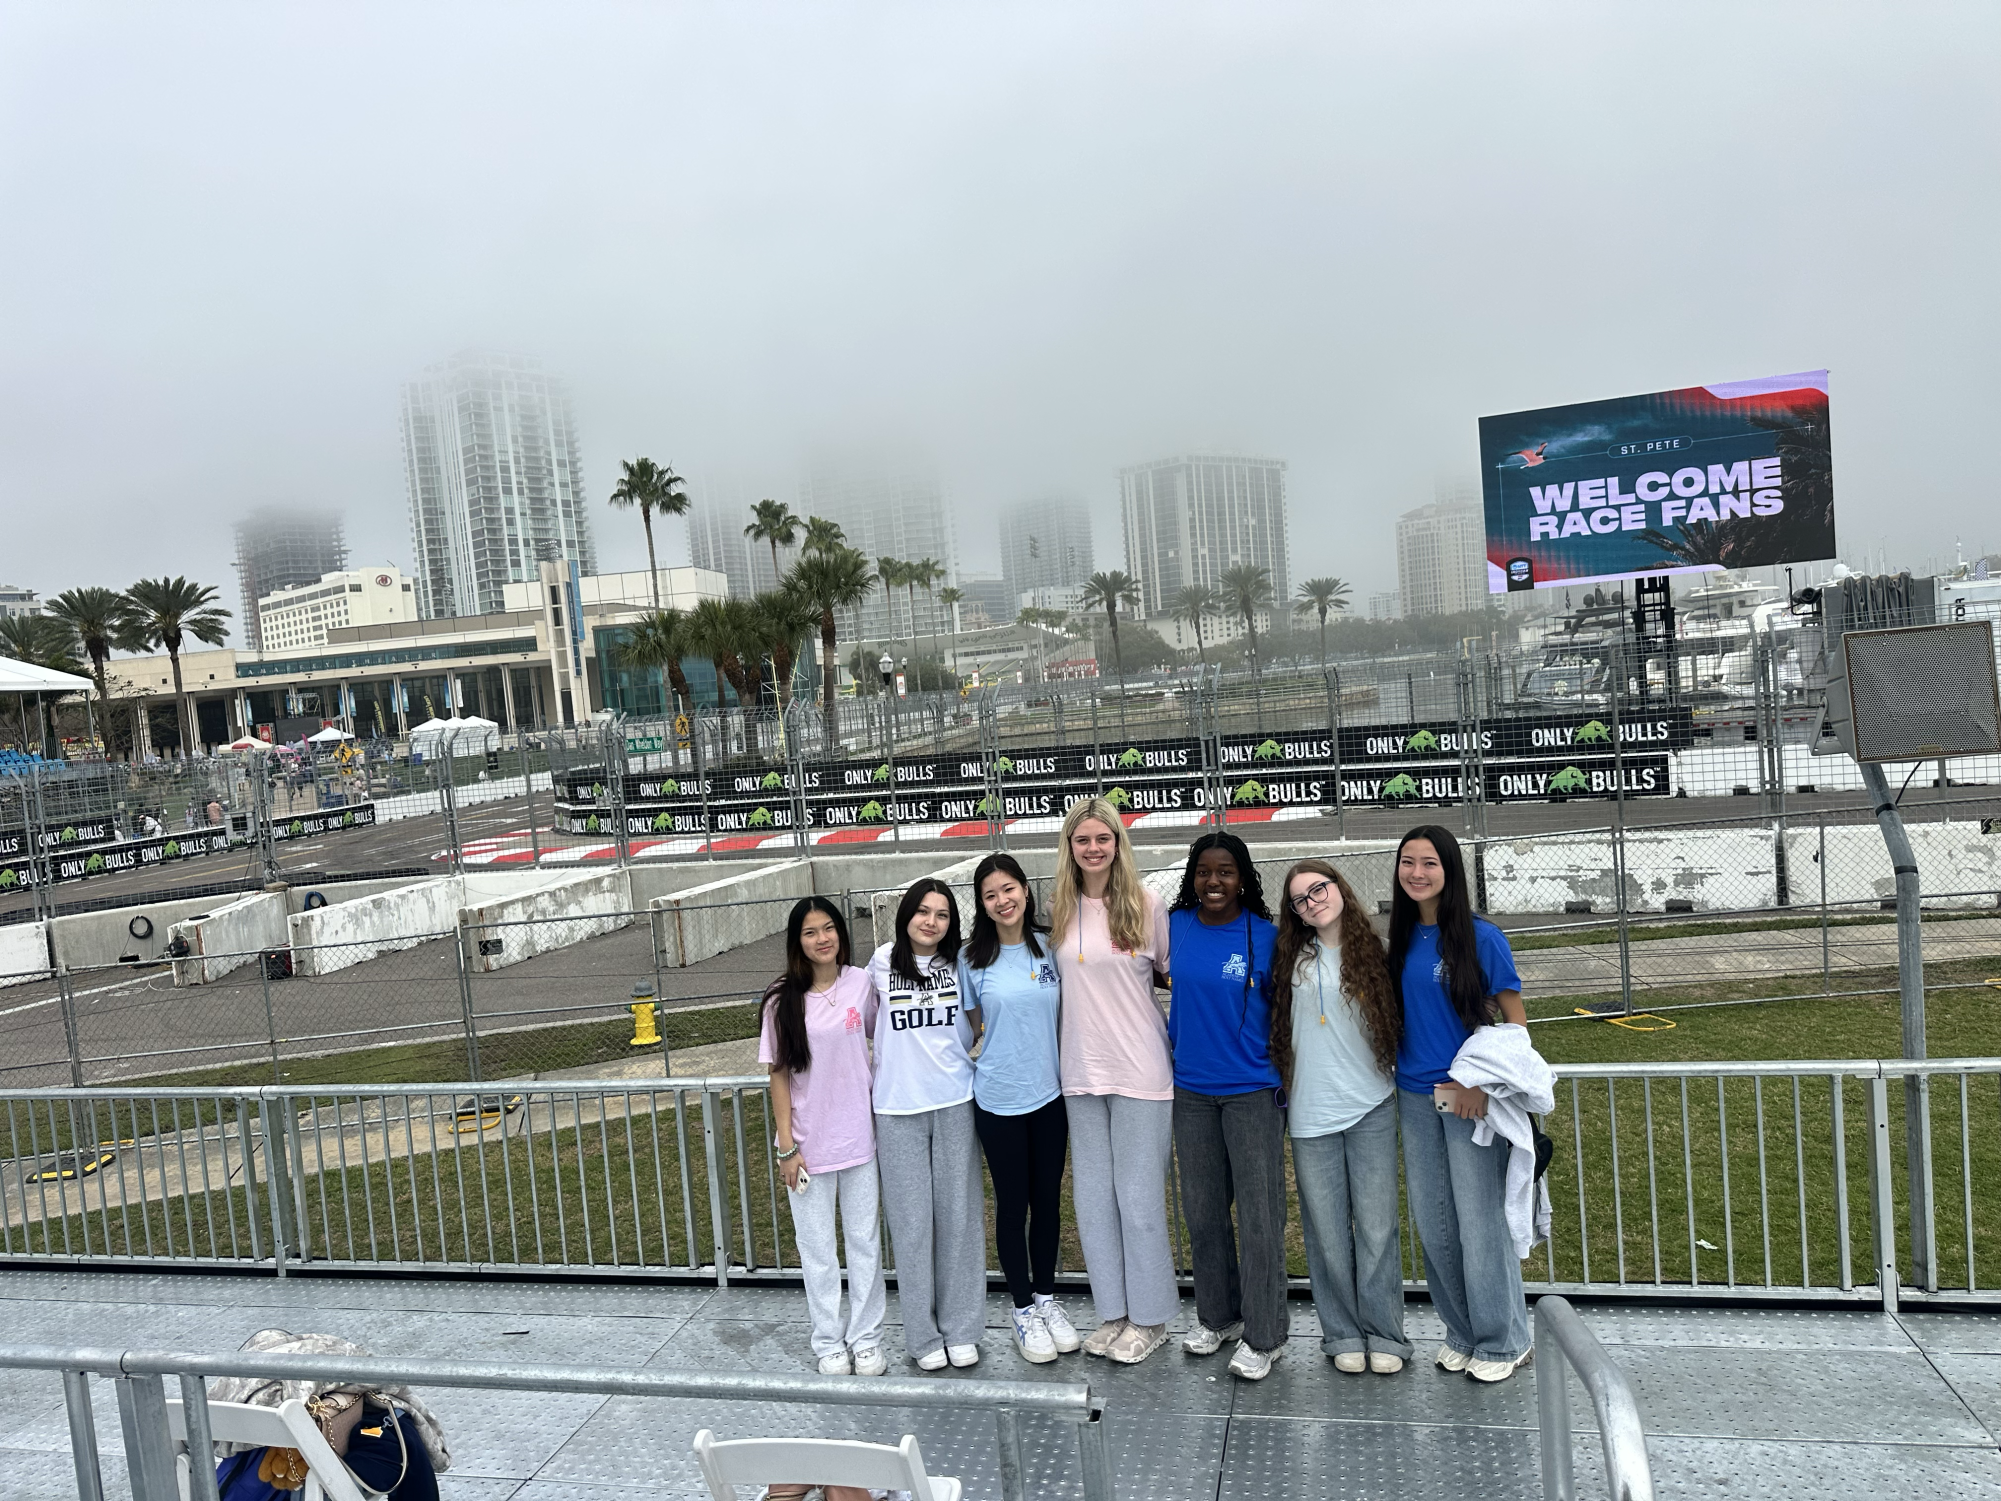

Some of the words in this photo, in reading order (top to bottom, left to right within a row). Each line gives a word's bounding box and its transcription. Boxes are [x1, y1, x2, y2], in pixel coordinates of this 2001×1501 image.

[1620, 444, 1641, 455] ST.
[1646, 438, 1680, 452] PETE
[1528, 456, 1783, 514] WELCOME
[1528, 503, 1647, 542] RACE
[1660, 488, 1785, 527] FANS
[1366, 735, 1406, 755] ONLY
[1440, 731, 1493, 751] BULLS
[1531, 726, 1574, 747] ONLY
[1618, 720, 1669, 742] BULLS
[1085, 753, 1118, 771] ONLY
[1145, 749, 1188, 768] BULLS
[1220, 744, 1254, 763] ONLY
[1284, 740, 1332, 760] BULLS
[844, 769, 873, 785] ONLY
[897, 764, 934, 781] BULLS
[1016, 757, 1056, 775] BULLS
[577, 785, 592, 799] ONLY
[640, 782, 661, 797] ONLY
[734, 776, 761, 792] ONLY
[1268, 781, 1322, 803] BULLS
[1340, 779, 1382, 801] ONLY
[1421, 776, 1481, 798] BULLS
[1500, 773, 1548, 796] ONLY
[1591, 768, 1656, 792] BULLS
[941, 799, 976, 819] ONLY
[1005, 795, 1051, 816] BULLS
[1133, 789, 1181, 809] BULLS
[328, 815, 343, 829] ONLY
[354, 810, 373, 824] BULLS
[628, 816, 653, 833] ONLY
[674, 814, 707, 832] BULLS
[717, 812, 748, 830] ONLY
[774, 808, 814, 827] BUS
[826, 806, 859, 825] ONLY
[886, 801, 929, 821] BULLS
[38, 832, 60, 847] ONLY
[78, 824, 105, 840] BULLS
[273, 824, 290, 839] ONLY
[303, 820, 325, 834] BULLS
[571, 817, 587, 833] ONLY
[600, 817, 620, 833] BUL
[0, 838, 19, 854] LLS
[142, 845, 163, 862] ONLY
[180, 838, 207, 856] BULLS
[61, 859, 86, 878] ONLY
[105, 851, 135, 869] BULLS
[19, 867, 53, 886] BUL
[890, 1004, 959, 1032] GOLF
